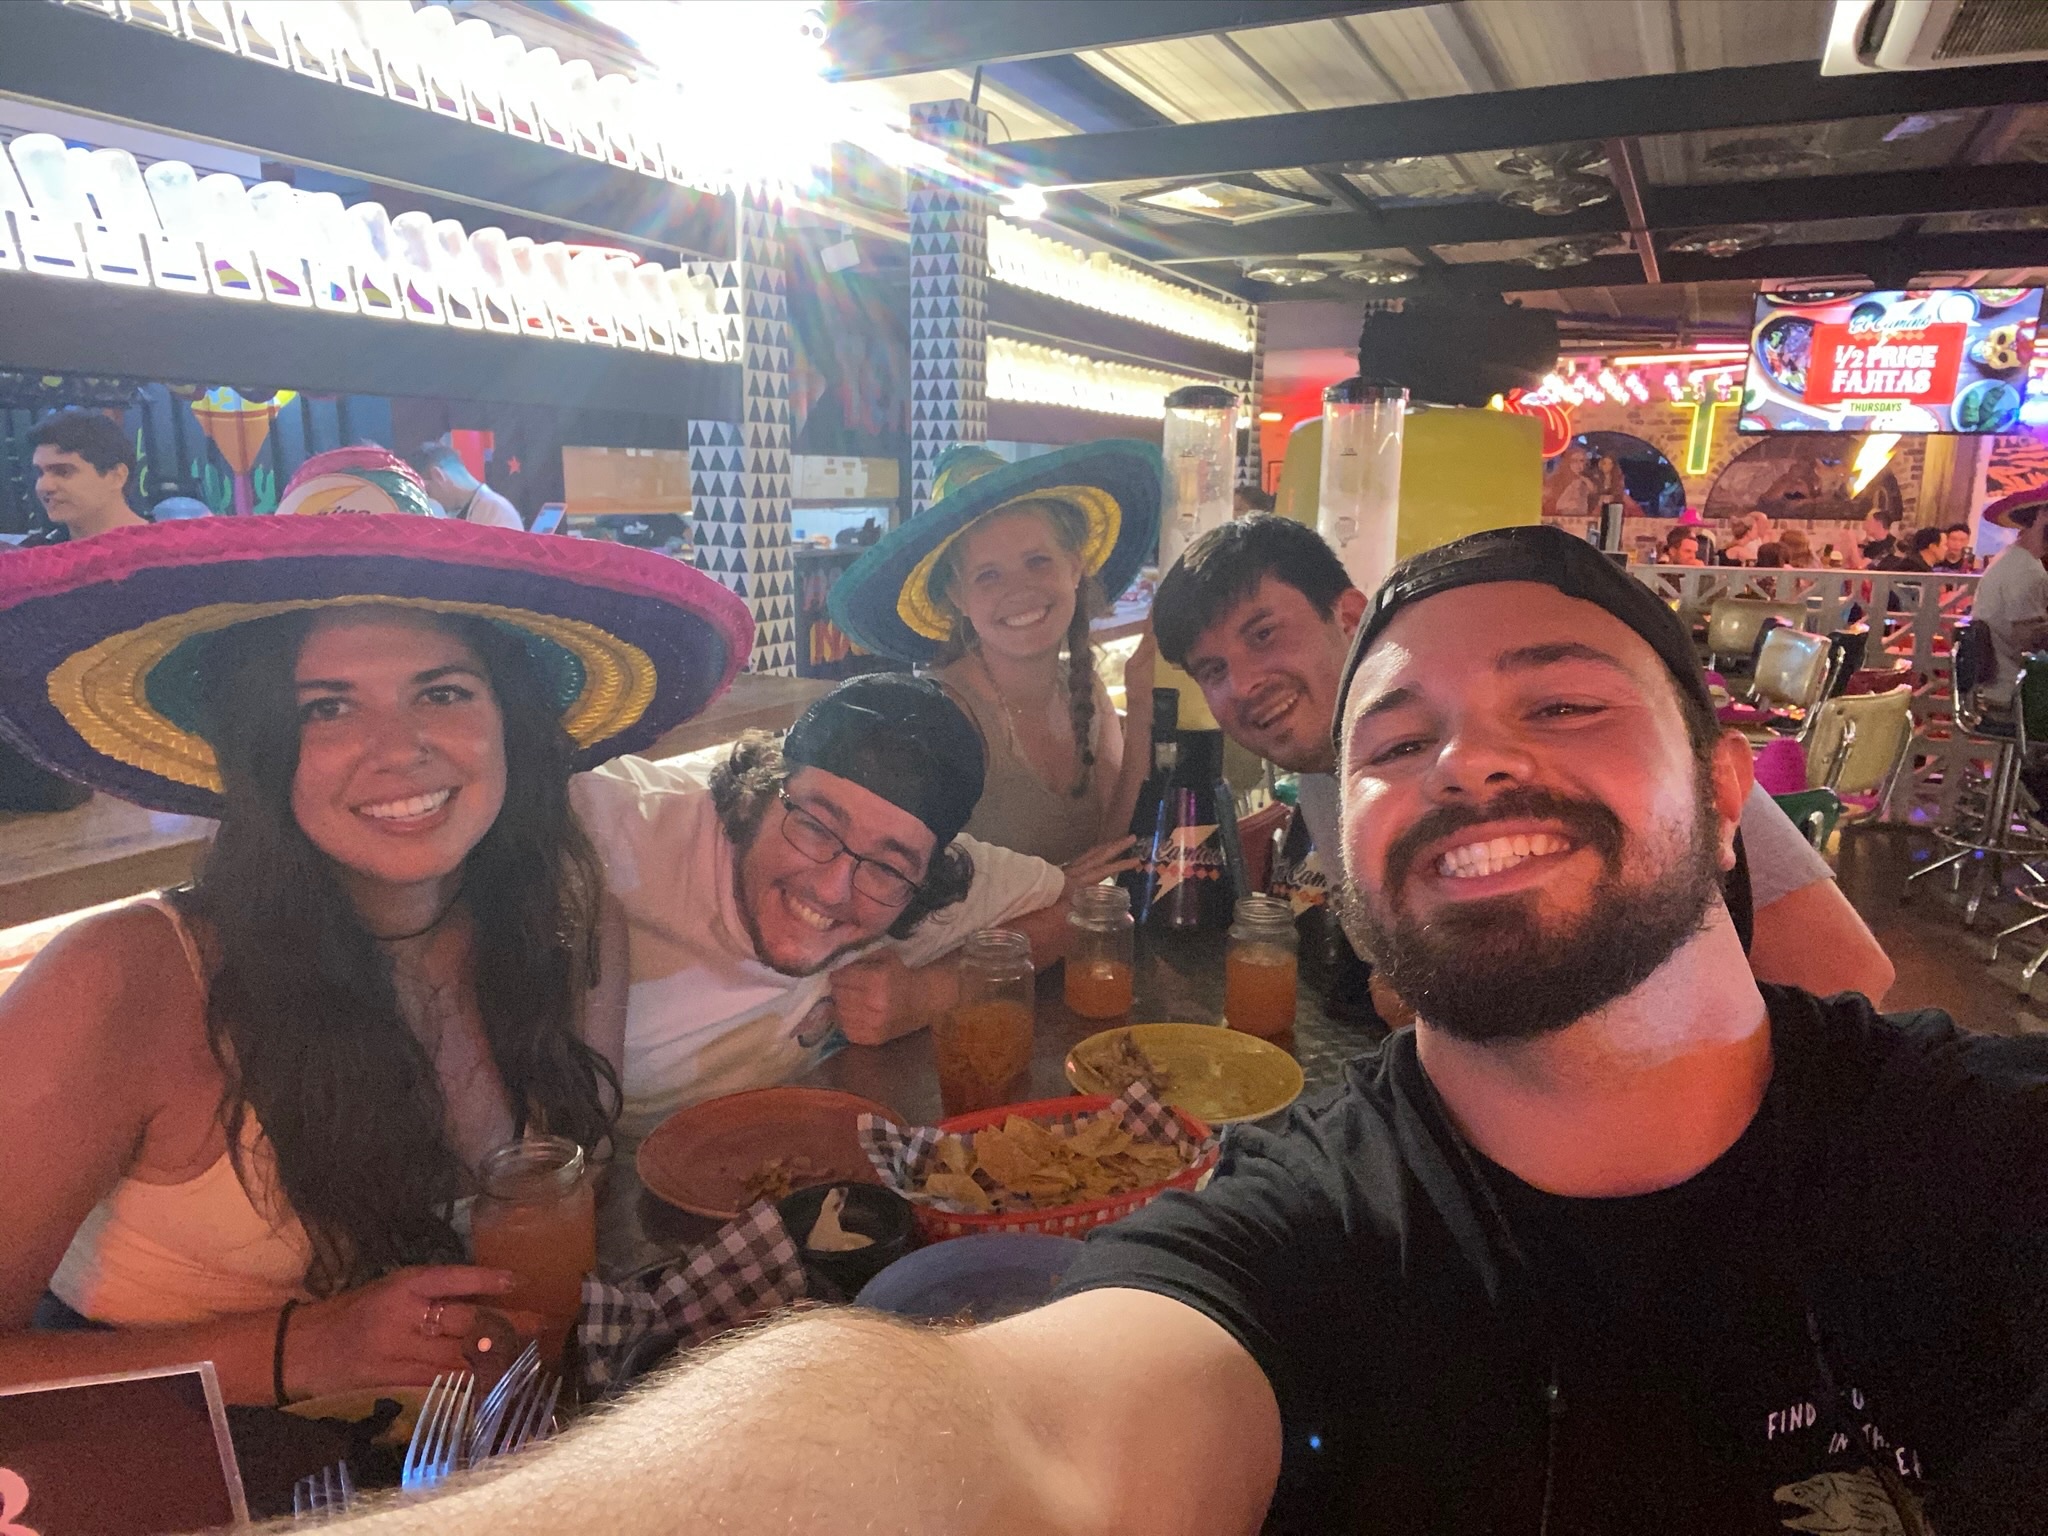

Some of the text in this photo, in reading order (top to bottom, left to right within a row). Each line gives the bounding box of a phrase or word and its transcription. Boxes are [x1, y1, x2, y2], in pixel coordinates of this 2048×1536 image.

[1866, 345, 1939, 368] PRICE
[1832, 369, 1931, 394] FAJITAS
[1850, 402, 1902, 412] THURSDAYS
[1768, 1402, 1817, 1440] FIND
